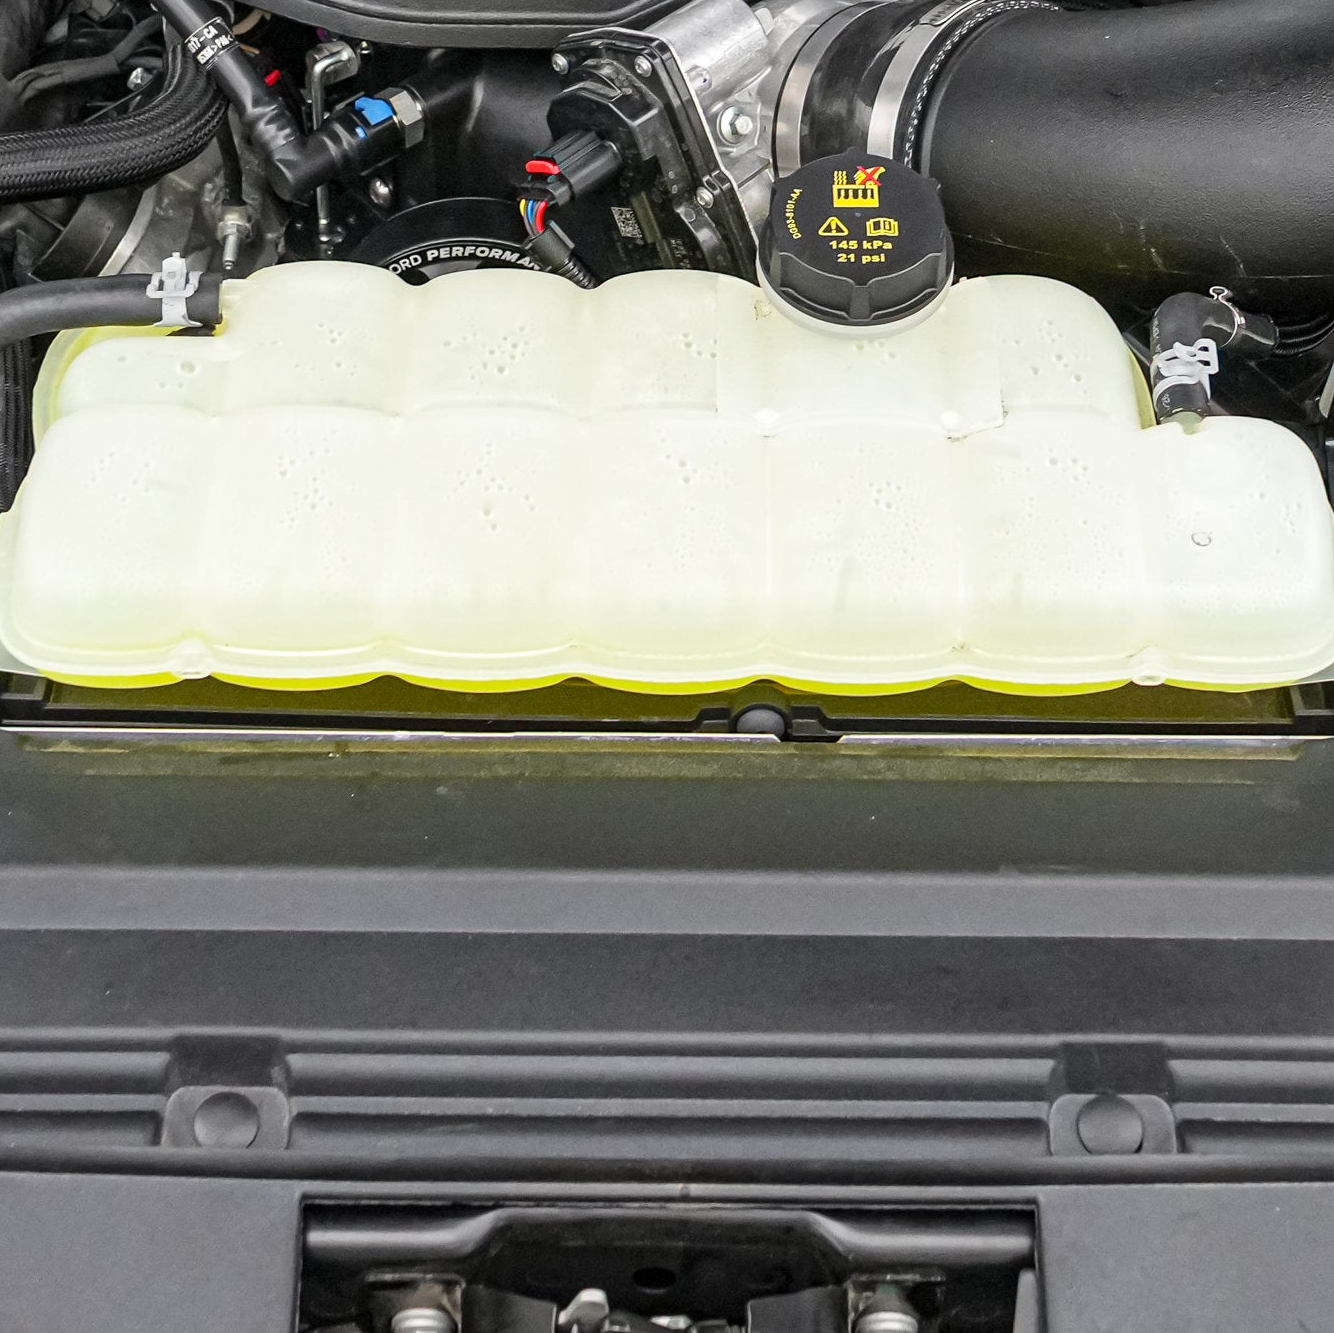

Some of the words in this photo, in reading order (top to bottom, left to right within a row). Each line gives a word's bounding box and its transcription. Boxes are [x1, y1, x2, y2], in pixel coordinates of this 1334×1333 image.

[829, 240, 858, 250] 145
[863, 240, 893, 250] kPa
[837, 253, 856, 263] 21
[861, 253, 886, 264] psi
[388, 254, 422, 275] ORD
